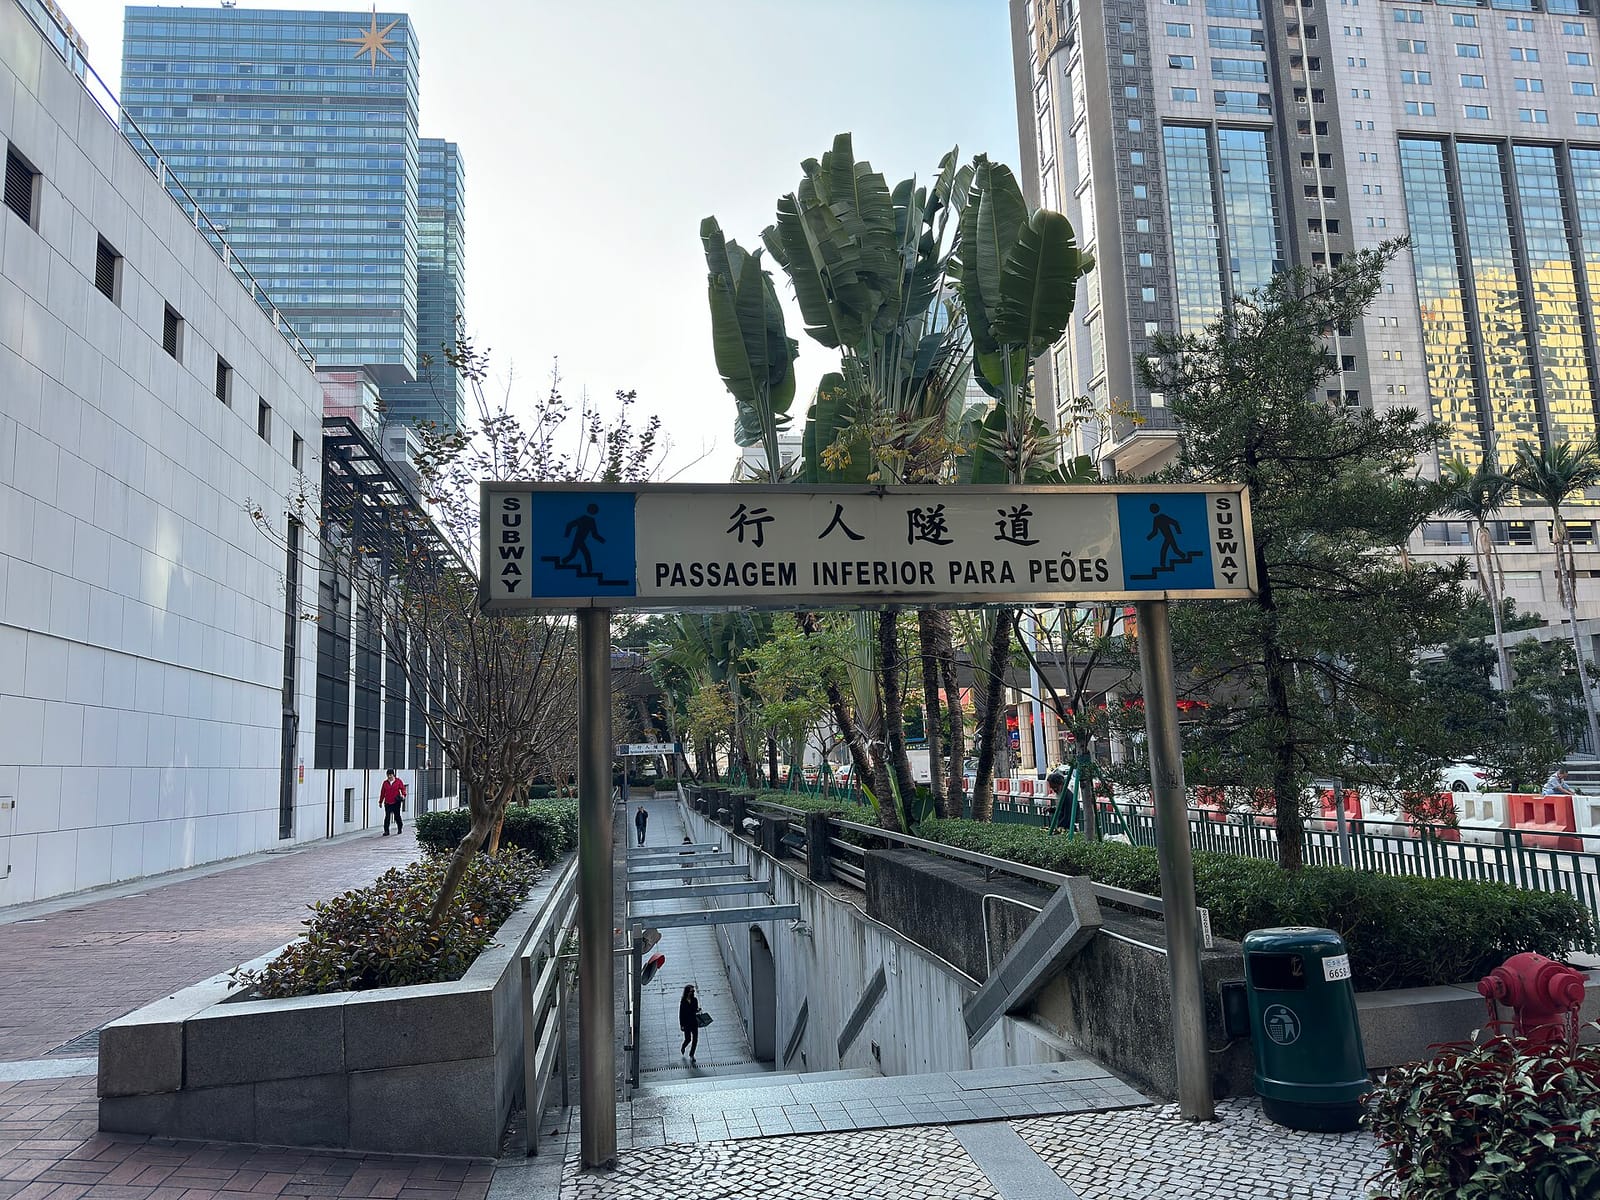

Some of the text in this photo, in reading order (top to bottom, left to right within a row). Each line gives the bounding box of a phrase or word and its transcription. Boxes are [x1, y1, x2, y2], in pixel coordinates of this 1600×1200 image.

[498, 498, 525, 593] SUBWAY
[726, 503, 1041, 549] 行人隧道
[1215, 497, 1239, 585] SUBWAY
[655, 550, 1109, 588] PASSAGEM INFERIOR PARA PEÕES
